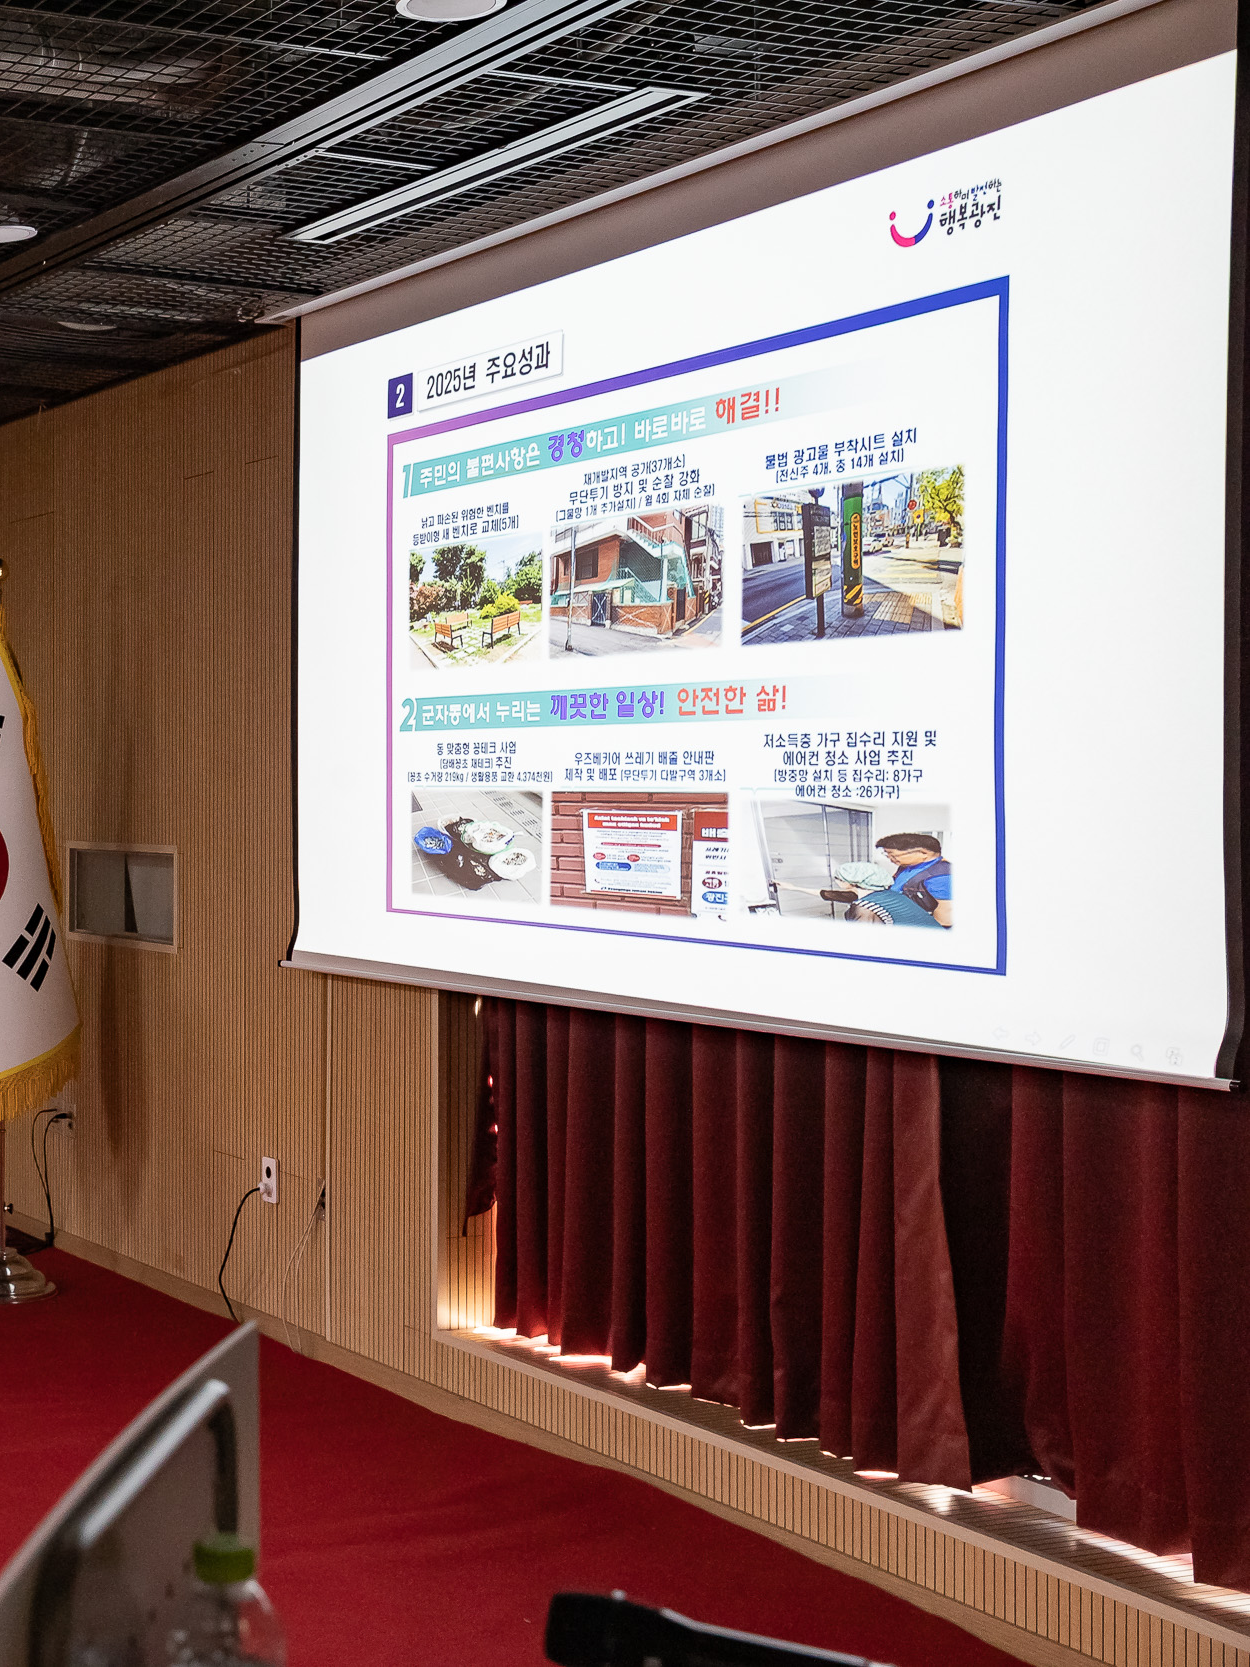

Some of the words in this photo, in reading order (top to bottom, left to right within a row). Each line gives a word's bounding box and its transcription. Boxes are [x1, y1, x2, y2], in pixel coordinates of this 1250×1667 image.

[939, 194, 1001, 235] 행복광진
[426, 362, 476, 400] 2025년
[486, 341, 551, 384] 주요성과
[395, 383, 405, 409] 2
[419, 460, 461, 488] 주민의
[466, 442, 541, 478] 불편사항은
[634, 406, 706, 442] 바로바로
[715, 386, 780, 425] 해결!!
[765, 452, 788, 471] 불법
[794, 444, 828, 465] 광고물
[834, 433, 886, 458] 부착시트
[892, 427, 917, 448] 설치
[583, 466, 628, 486] 재개발지역
[631, 454, 686, 478] 공가(37개소)
[776, 466, 809, 484] (전신주
[836, 459, 846, 474] 총
[850, 454, 874, 470] 14개
[879, 448, 905, 467] 설치)
[569, 485, 608, 506] 무단투기
[613, 481, 634, 498] 방지
[638, 478, 648, 494] 및
[652, 474, 674, 491] 순찰
[679, 468, 700, 487] 강화
[586, 504, 597, 516] 1개
[656, 492, 670, 504] 4회
[674, 488, 690, 502] 자체
[694, 484, 715, 498] 순찰)
[421, 515, 435, 529] 낡고
[437, 511, 458, 526] 파손된
[461, 506, 484, 522] 위험한
[486, 502, 509, 518] 벤치를
[412, 530, 440, 546] 등받이형
[441, 528, 450, 541] 새
[452, 522, 478, 539] 벤치로
[482, 515, 520, 534] 교체(5개)
[400, 698, 416, 732] 2
[422, 702, 490, 726] 군자동에서
[496, 700, 541, 722] 누리는
[550, 692, 609, 720] 깨끗한
[616, 690, 665, 718] 일상!
[676, 684, 747, 716] 안전한
[756, 684, 786, 713] 삶!
[436, 742, 444, 756] 동
[446, 742, 470, 756] 맞춤형
[500, 740, 517, 754] 사업
[763, 734, 812, 749] 저소득층
[816, 733, 841, 748] 가구
[846, 732, 886, 748] 집수리
[891, 730, 918, 748] 지원
[924, 730, 938, 748] 및
[496, 756, 512, 769] 추진
[574, 752, 621, 766] 우즈베키어
[624, 752, 654, 766] 쓰레기
[658, 752, 678, 766] 배출
[682, 750, 715, 766] 안내판
[782, 750, 820, 766] 에어컨
[824, 750, 849, 766] 청소
[854, 750, 881, 766] 사업
[886, 750, 914, 766] 추진
[424, 772, 443, 782] 수거량
[444, 772, 464, 782] 219kg
[500, 772, 514, 782] 교환
[564, 768, 583, 782] 제작
[586, 768, 595, 782] 및
[598, 768, 617, 782] 배포
[660, 769, 696, 782] 다발구역
[698, 769, 726, 782] 3개소)
[774, 769, 808, 784] (방충망
[812, 769, 833, 783] 설치
[837, 769, 848, 783] 등
[852, 769, 889, 783] 집수리:
[893, 769, 924, 783] 8가구
[795, 784, 827, 798] 에어컨
[830, 784, 852, 798] 청소
